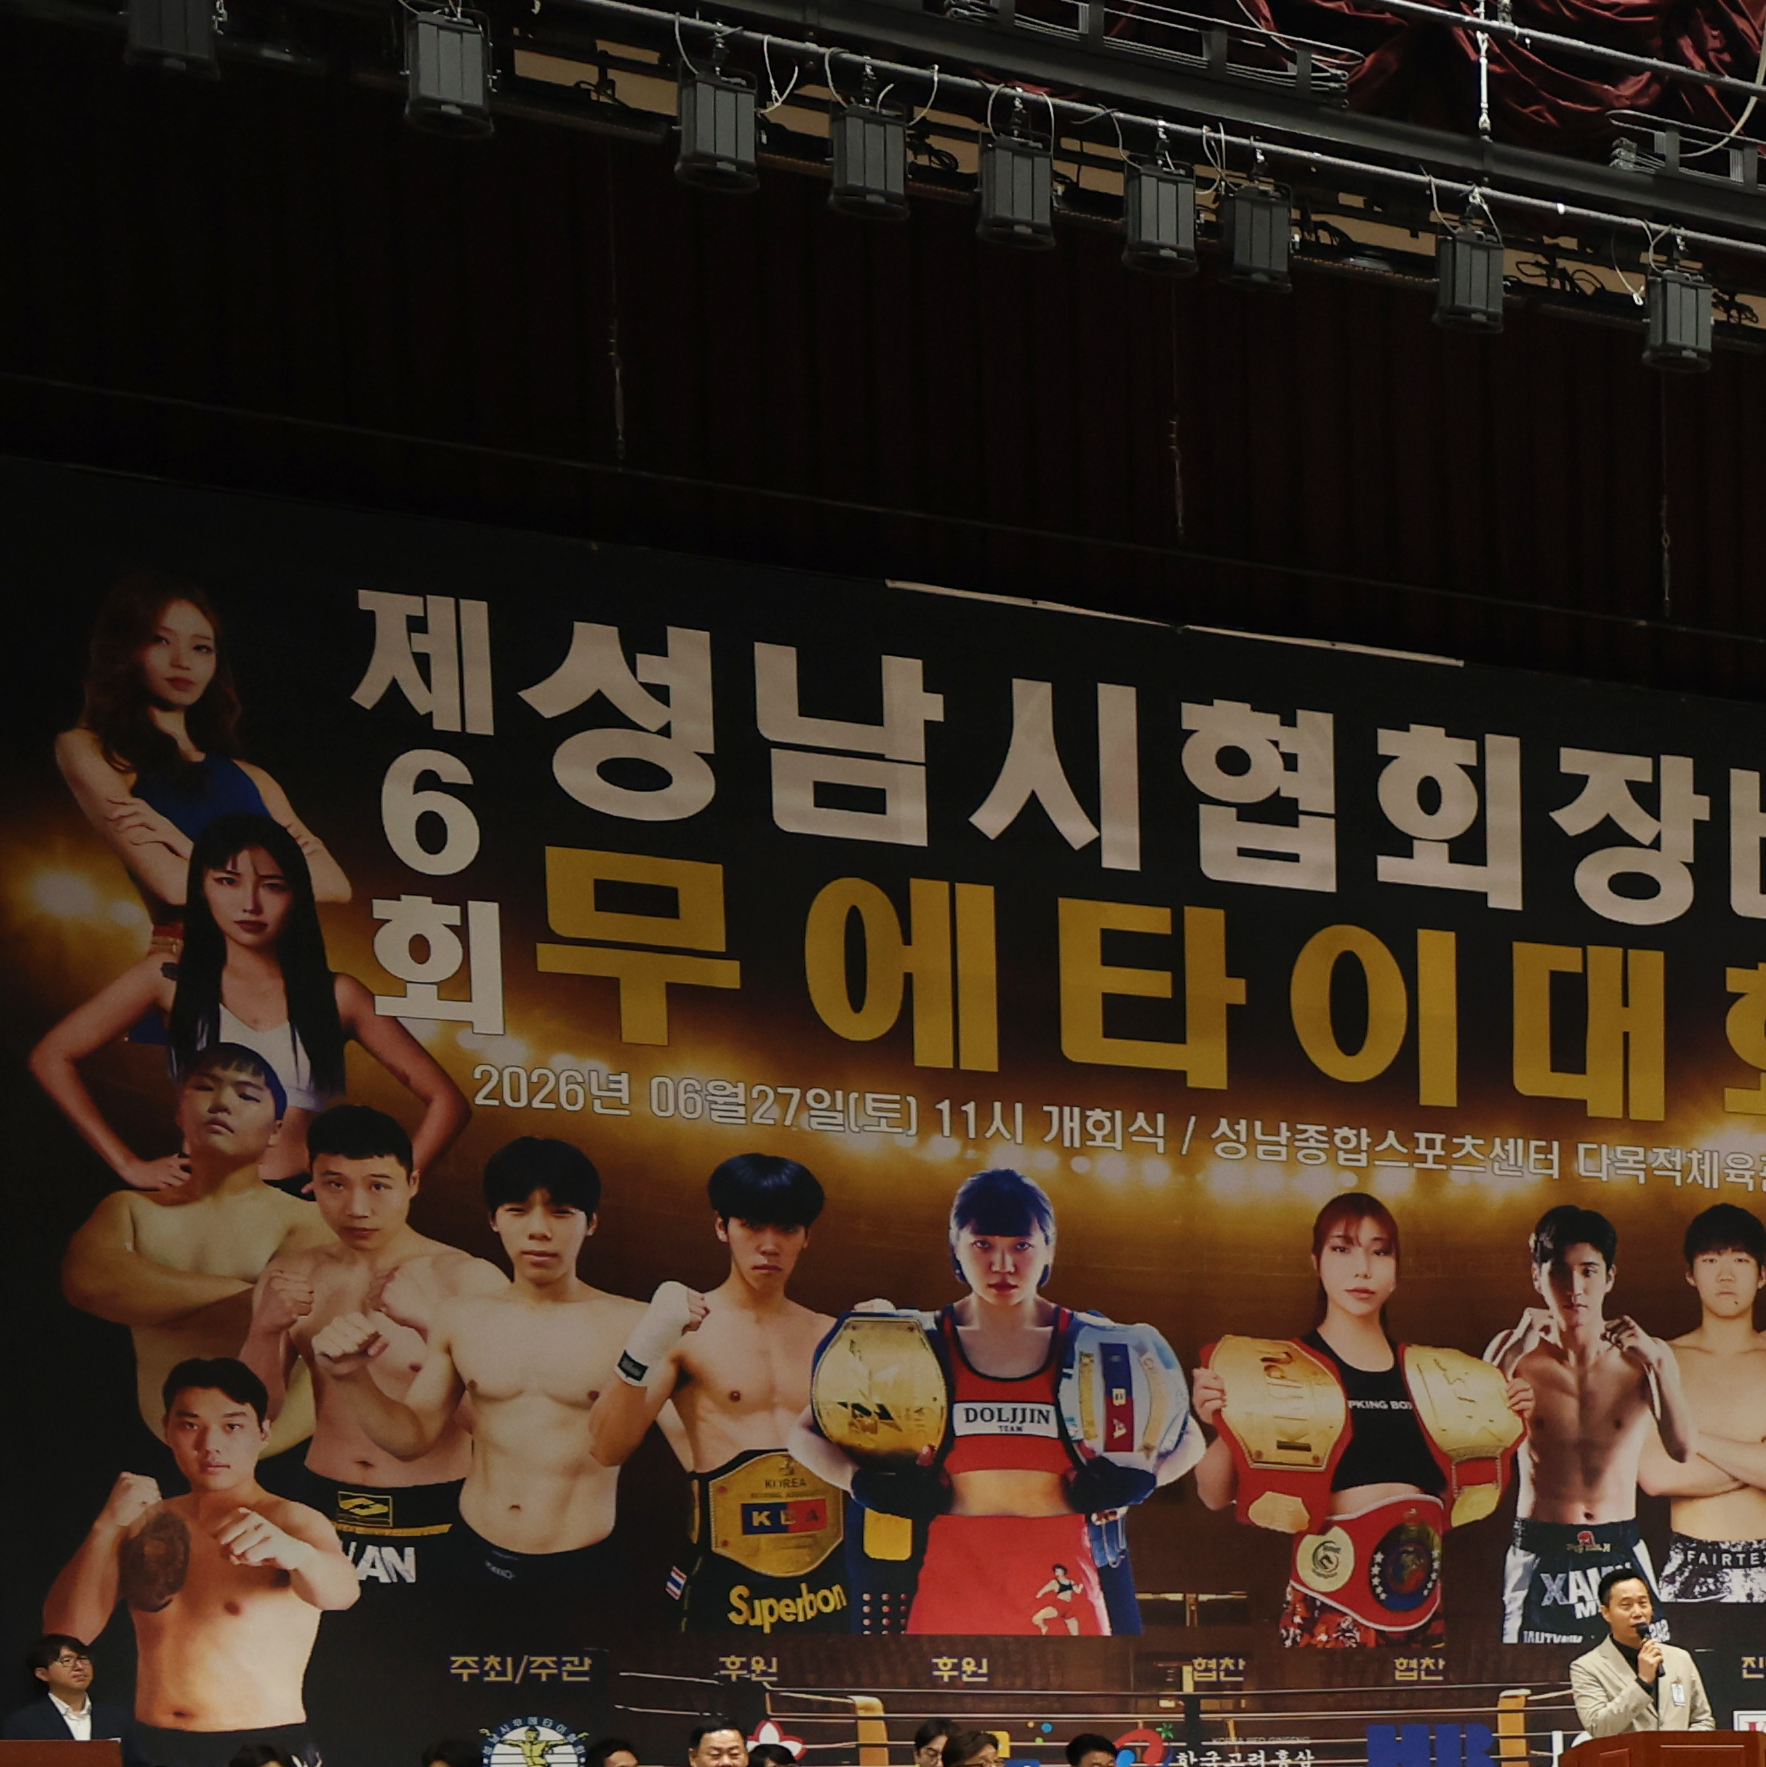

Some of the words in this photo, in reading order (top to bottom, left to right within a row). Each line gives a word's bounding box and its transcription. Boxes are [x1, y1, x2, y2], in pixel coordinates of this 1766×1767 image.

[472, 1064, 630, 1118] 2026년
[936, 1099, 1023, 1145] 11시
[1043, 1104, 1166, 1155] 개회식
[1181, 1114, 1196, 1156] /
[1211, 1117, 1561, 1181] 성남종합스포츠센터
[964, 1407, 1050, 1425] DOLJJIN
[727, 1582, 848, 1634] Superbon
[450, 1655, 592, 1684] 주최/주관
[719, 1655, 779, 1682] 후원
[932, 1656, 988, 1683] 후원
[1192, 1657, 1246, 1682] 협찬
[1394, 1657, 1445, 1682] 협찬
